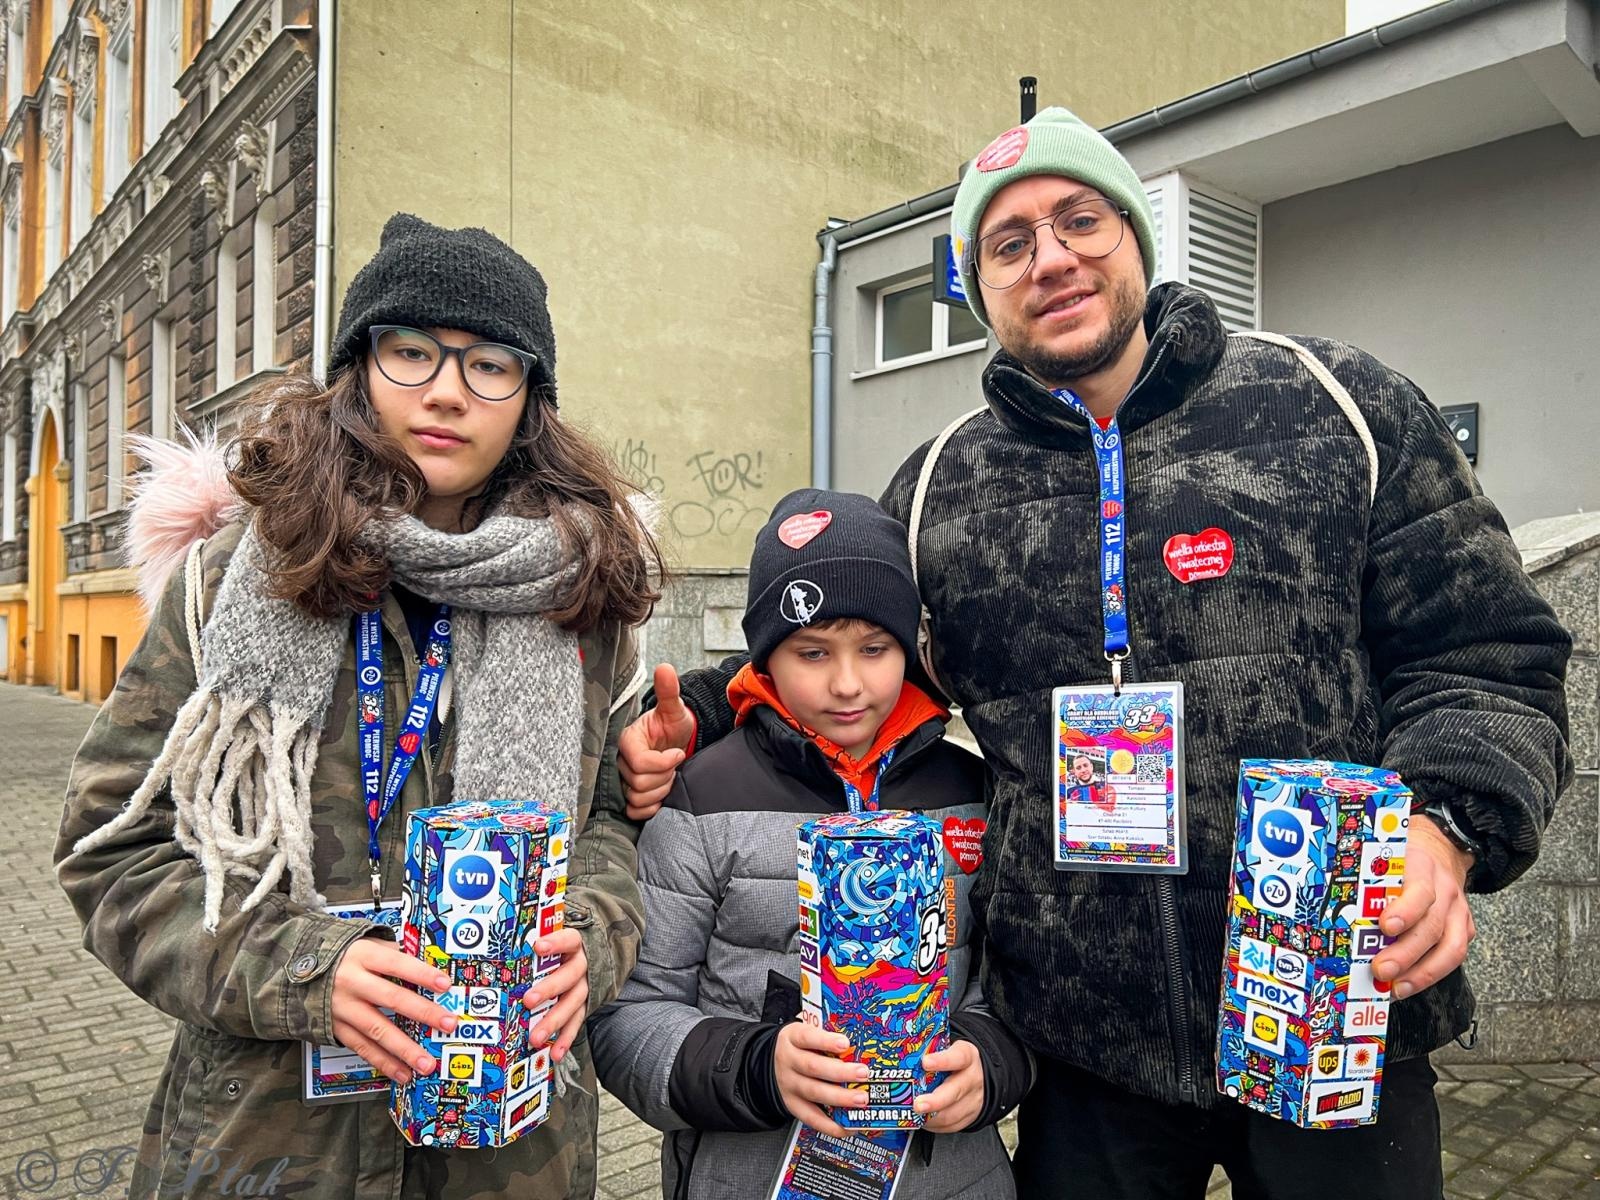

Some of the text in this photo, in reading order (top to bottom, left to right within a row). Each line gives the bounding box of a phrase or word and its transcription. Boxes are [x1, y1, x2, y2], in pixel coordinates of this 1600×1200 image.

[1105, 522, 1121, 546] 112
[431, 643, 443, 663] 33
[420, 673, 430, 695] POMOC
[426, 672, 439, 702] PIERWSZA
[364, 695, 380, 717] 33
[407, 704, 428, 729] 112
[1125, 704, 1157, 728] 33
[366, 769, 379, 794] 112
[964, 827, 985, 839] orkiestr
[1264, 821, 1297, 844] tvn
[952, 838, 982, 851] świąteczne
[455, 868, 489, 885] tvn
[1266, 884, 1284, 899] PZU
[944, 878, 957, 946] BRUNOTTI
[459, 928, 477, 941] PZU
[1243, 977, 1299, 1010] max
[1352, 1006, 1387, 1026] alle
[1319, 1056, 1338, 1072] ups
[512, 1070, 525, 1087] ups
[847, 1110, 913, 1121] WOSP.ORG.PL
